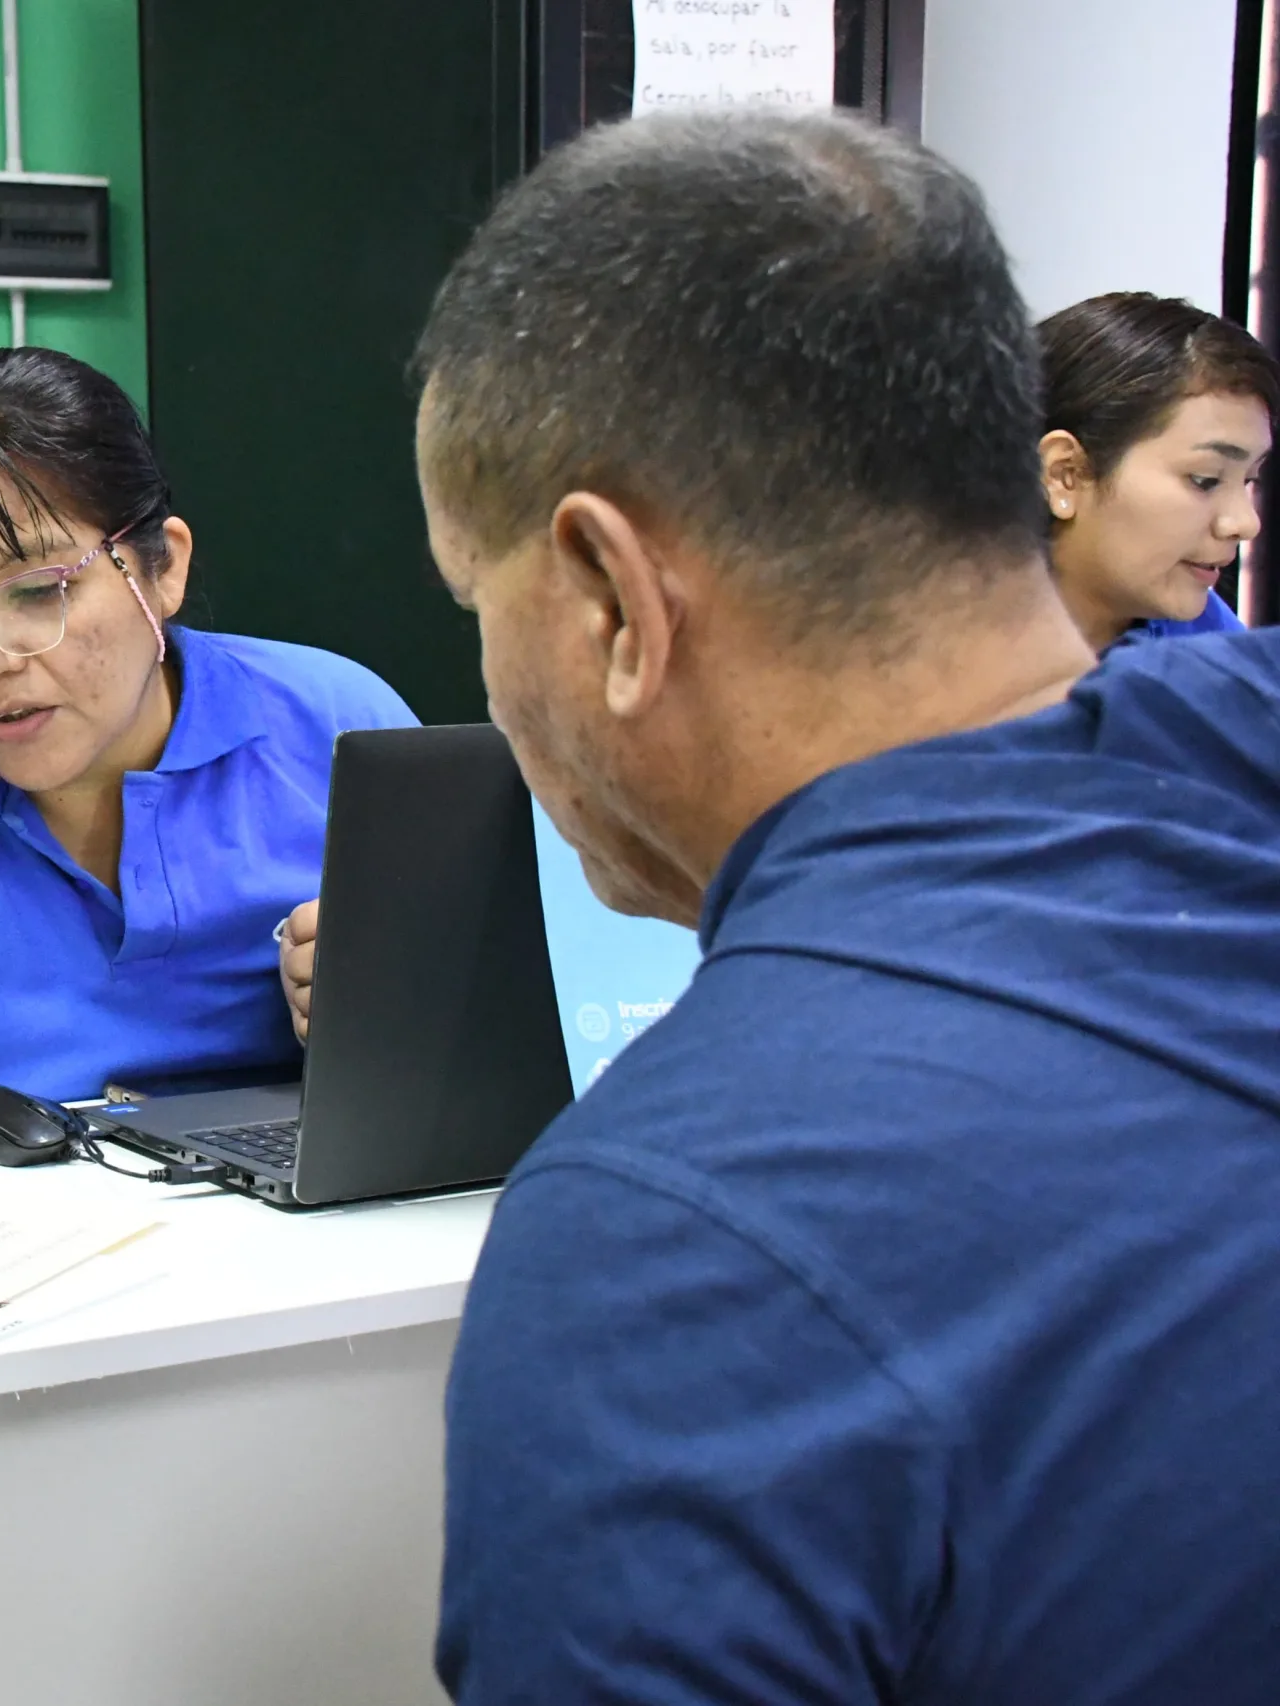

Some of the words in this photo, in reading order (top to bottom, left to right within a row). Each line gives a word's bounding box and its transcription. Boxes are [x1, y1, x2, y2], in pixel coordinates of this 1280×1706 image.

[673, 0, 761, 24] desocupar
[773, 0, 791, 17] la
[707, 41, 737, 62] por
[748, 38, 800, 68] favor
